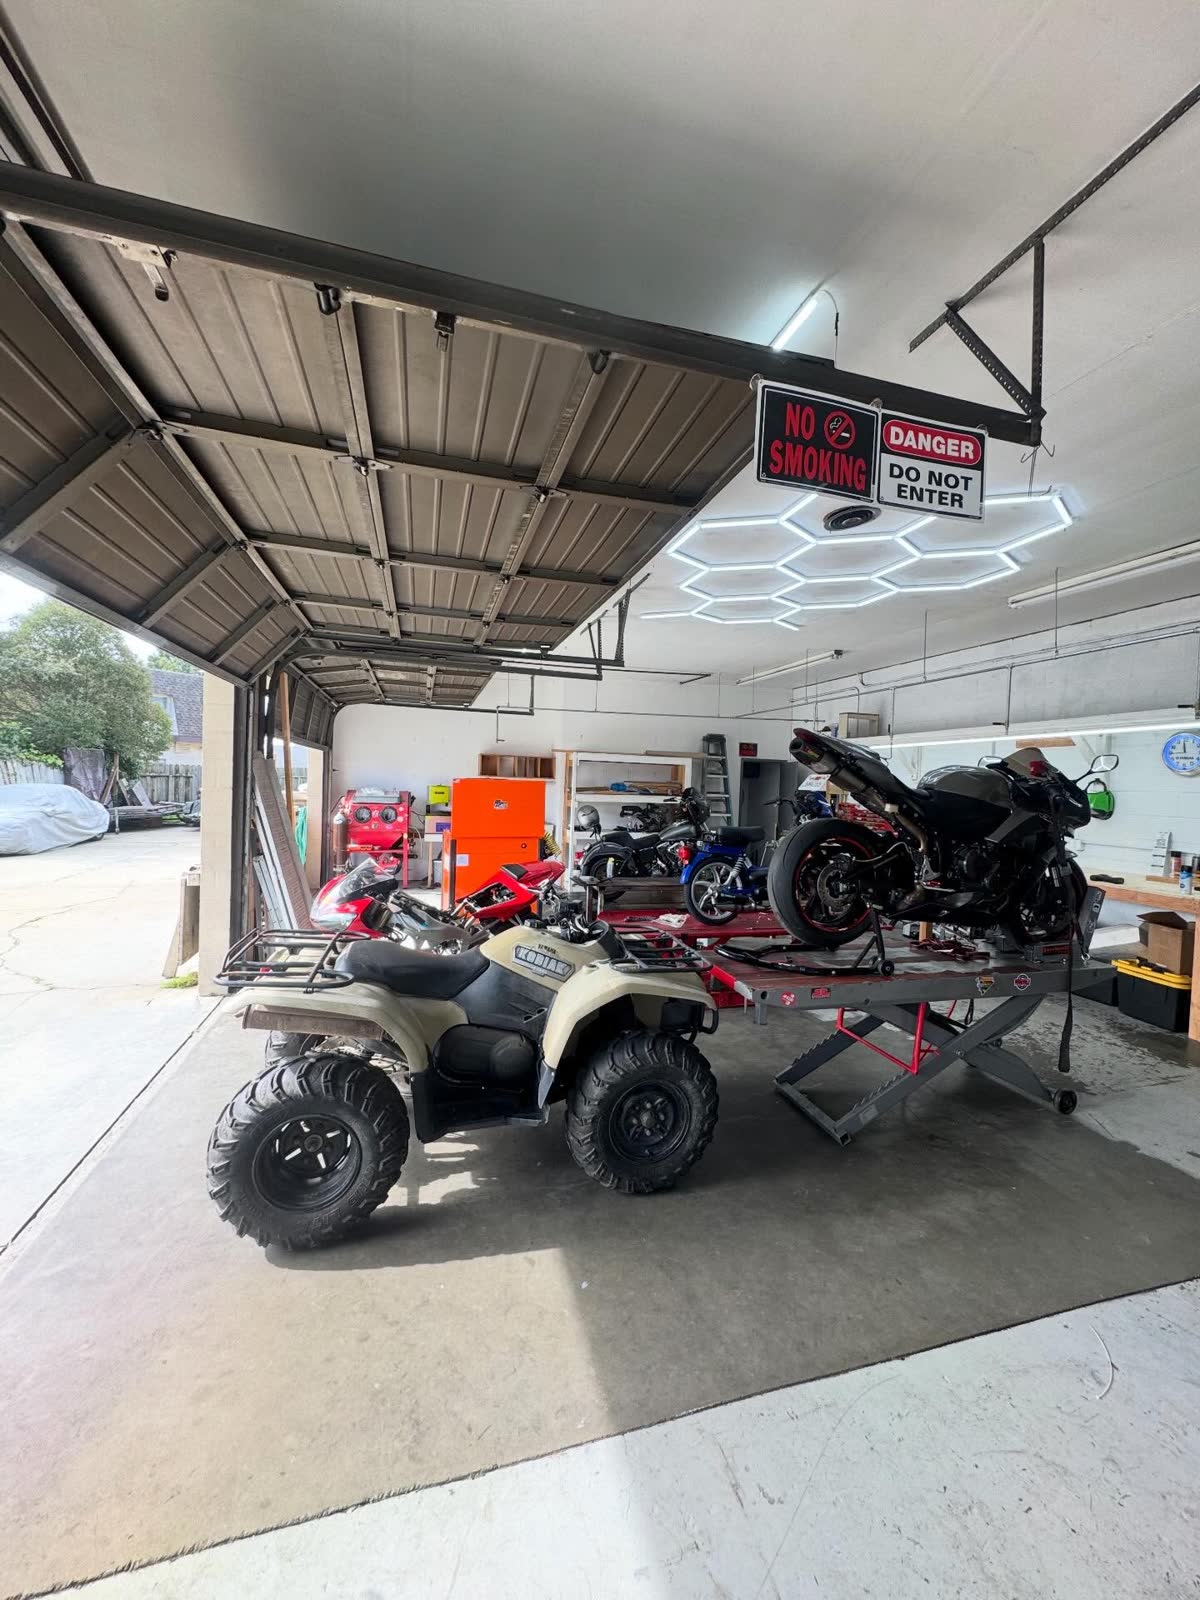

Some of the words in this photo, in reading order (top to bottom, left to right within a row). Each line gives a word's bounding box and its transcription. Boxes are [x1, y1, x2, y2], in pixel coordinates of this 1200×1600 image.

[785, 402, 815, 440] NO
[889, 425, 974, 459] DANGER
[769, 439, 867, 491] SMOKING
[889, 462, 921, 482] DO
[928, 470, 973, 491] NOT
[897, 483, 964, 508] ENTER
